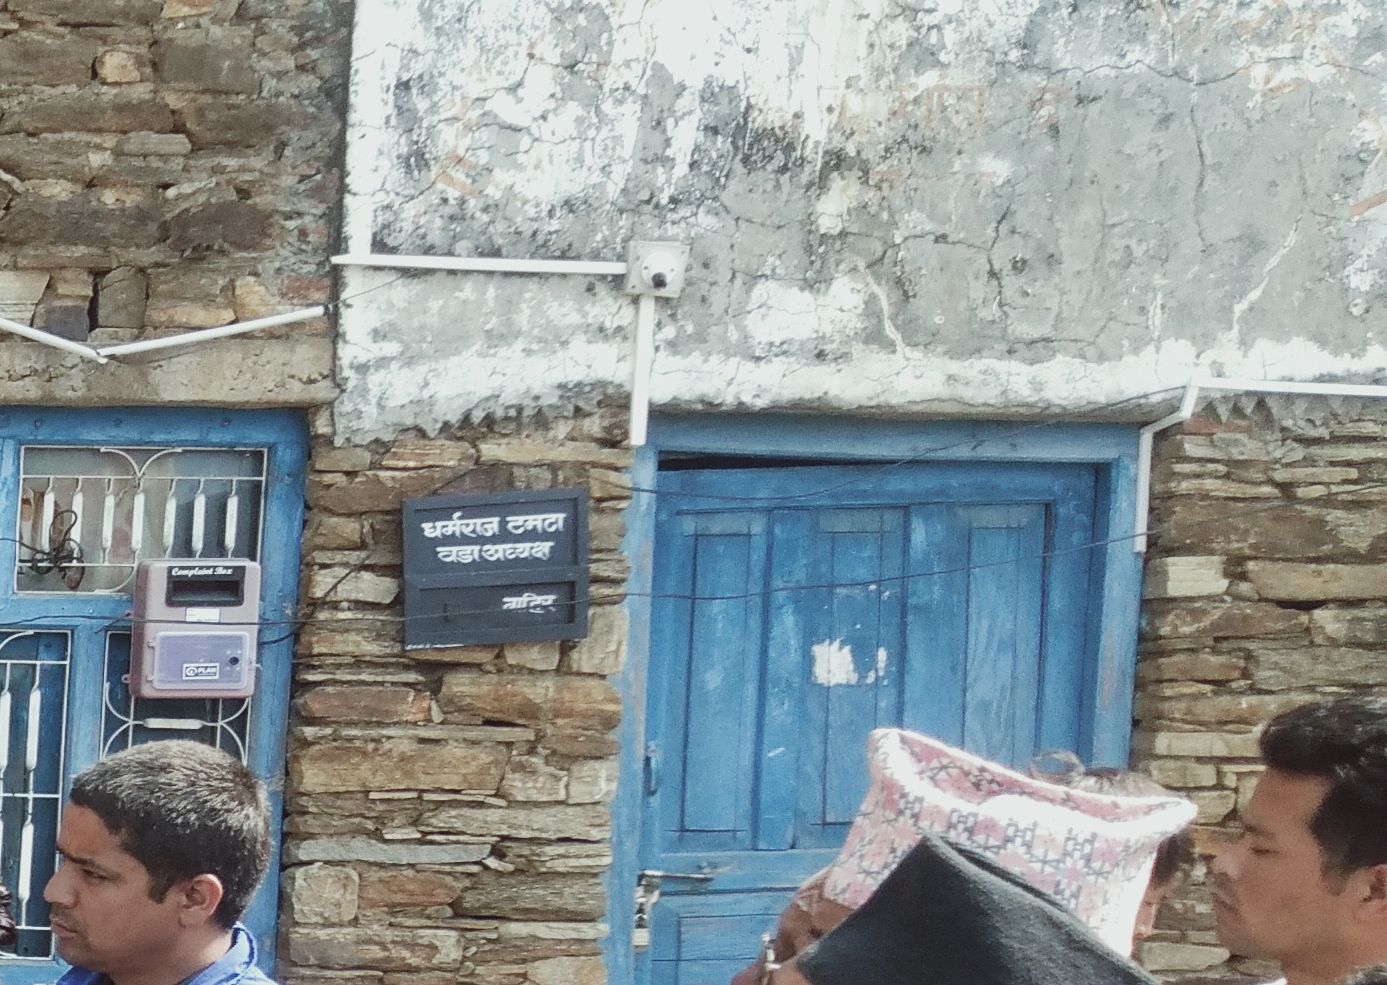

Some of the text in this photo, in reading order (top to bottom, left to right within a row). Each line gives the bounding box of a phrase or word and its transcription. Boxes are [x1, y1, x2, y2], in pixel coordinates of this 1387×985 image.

[420, 511, 567, 539] धर्मराज टमटा
[435, 541, 556, 563] वडा अध्यक्ष
[171, 565, 234, 578] Complaint Box
[197, 665, 217, 674] PLAN
